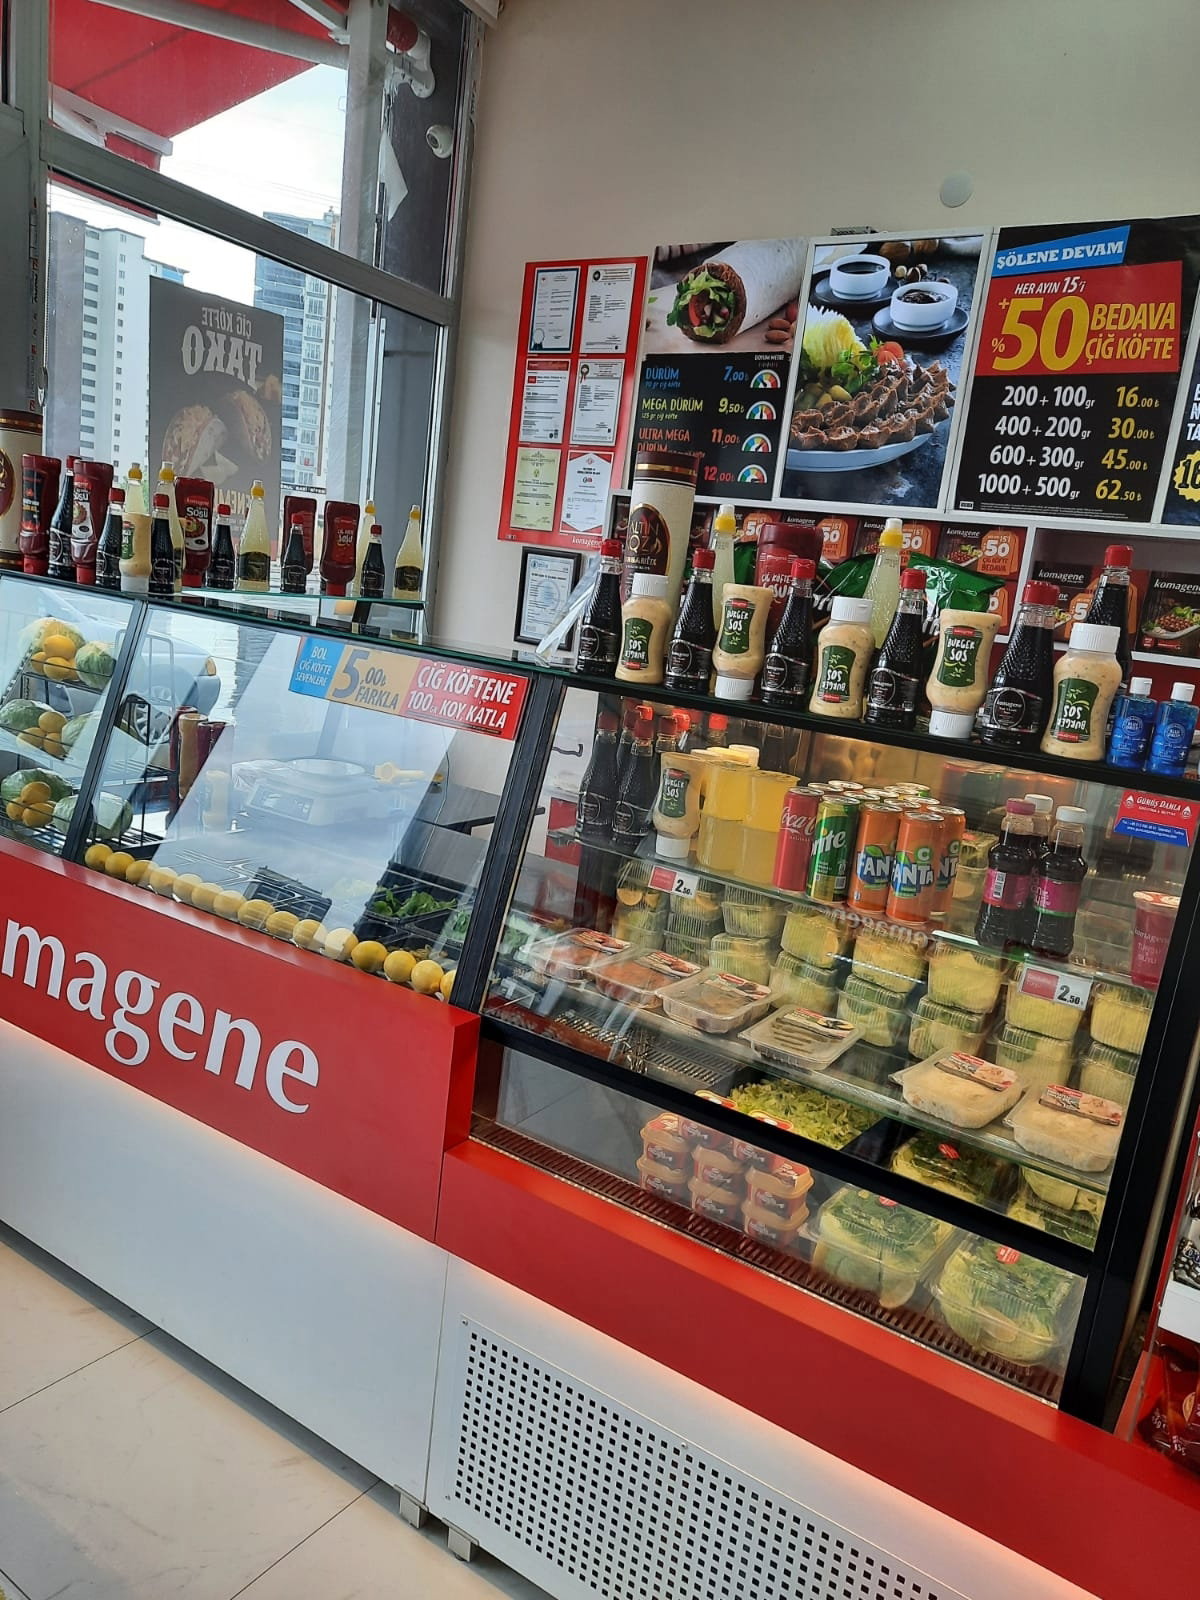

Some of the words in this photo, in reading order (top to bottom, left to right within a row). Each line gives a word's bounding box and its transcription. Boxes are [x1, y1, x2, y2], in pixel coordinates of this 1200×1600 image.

[997, 249, 1059, 269] ŞÖLENE
[1064, 241, 1124, 261] DEVAM
[1015, 283, 1036, 295] HER
[1036, 282, 1059, 294] AYIN
[1091, 302, 1175, 330] BEDAVA
[992, 295, 1090, 371] 50
[1085, 335, 1113, 364] ÇİĞ
[1115, 334, 1174, 360] KÖFTE
[1001, 385, 1038, 407] 200
[641, 398, 667, 411] MEGA
[670, 397, 703, 412] DÜRÜM
[995, 416, 1031, 436] 400
[639, 428, 663, 441] ULTRA
[665, 429, 690, 442] MEGA
[990, 445, 1025, 465] 600
[978, 473, 1021, 495] 1000
[946, 528, 981, 538] komagene
[1038, 569, 1085, 583] komagene
[727, 609, 748, 621] BURGER
[728, 619, 742, 631] SOS
[628, 638, 642, 650] SOS
[947, 638, 975, 650] BURGER
[311, 646, 328, 660] BOL
[950, 648, 968, 662] SOS
[312, 661, 331, 676] KÖFTE
[827, 669, 843, 682] SOS
[417, 661, 441, 689] ÇİĞ
[446, 667, 518, 704] KÖFTENE
[355, 686, 399, 710] FARKLA
[465, 706, 508, 729] KATLA
[1063, 704, 1082, 719] SOS
[665, 787, 680, 798] SOS
[1, 919, 319, 1114] magene
